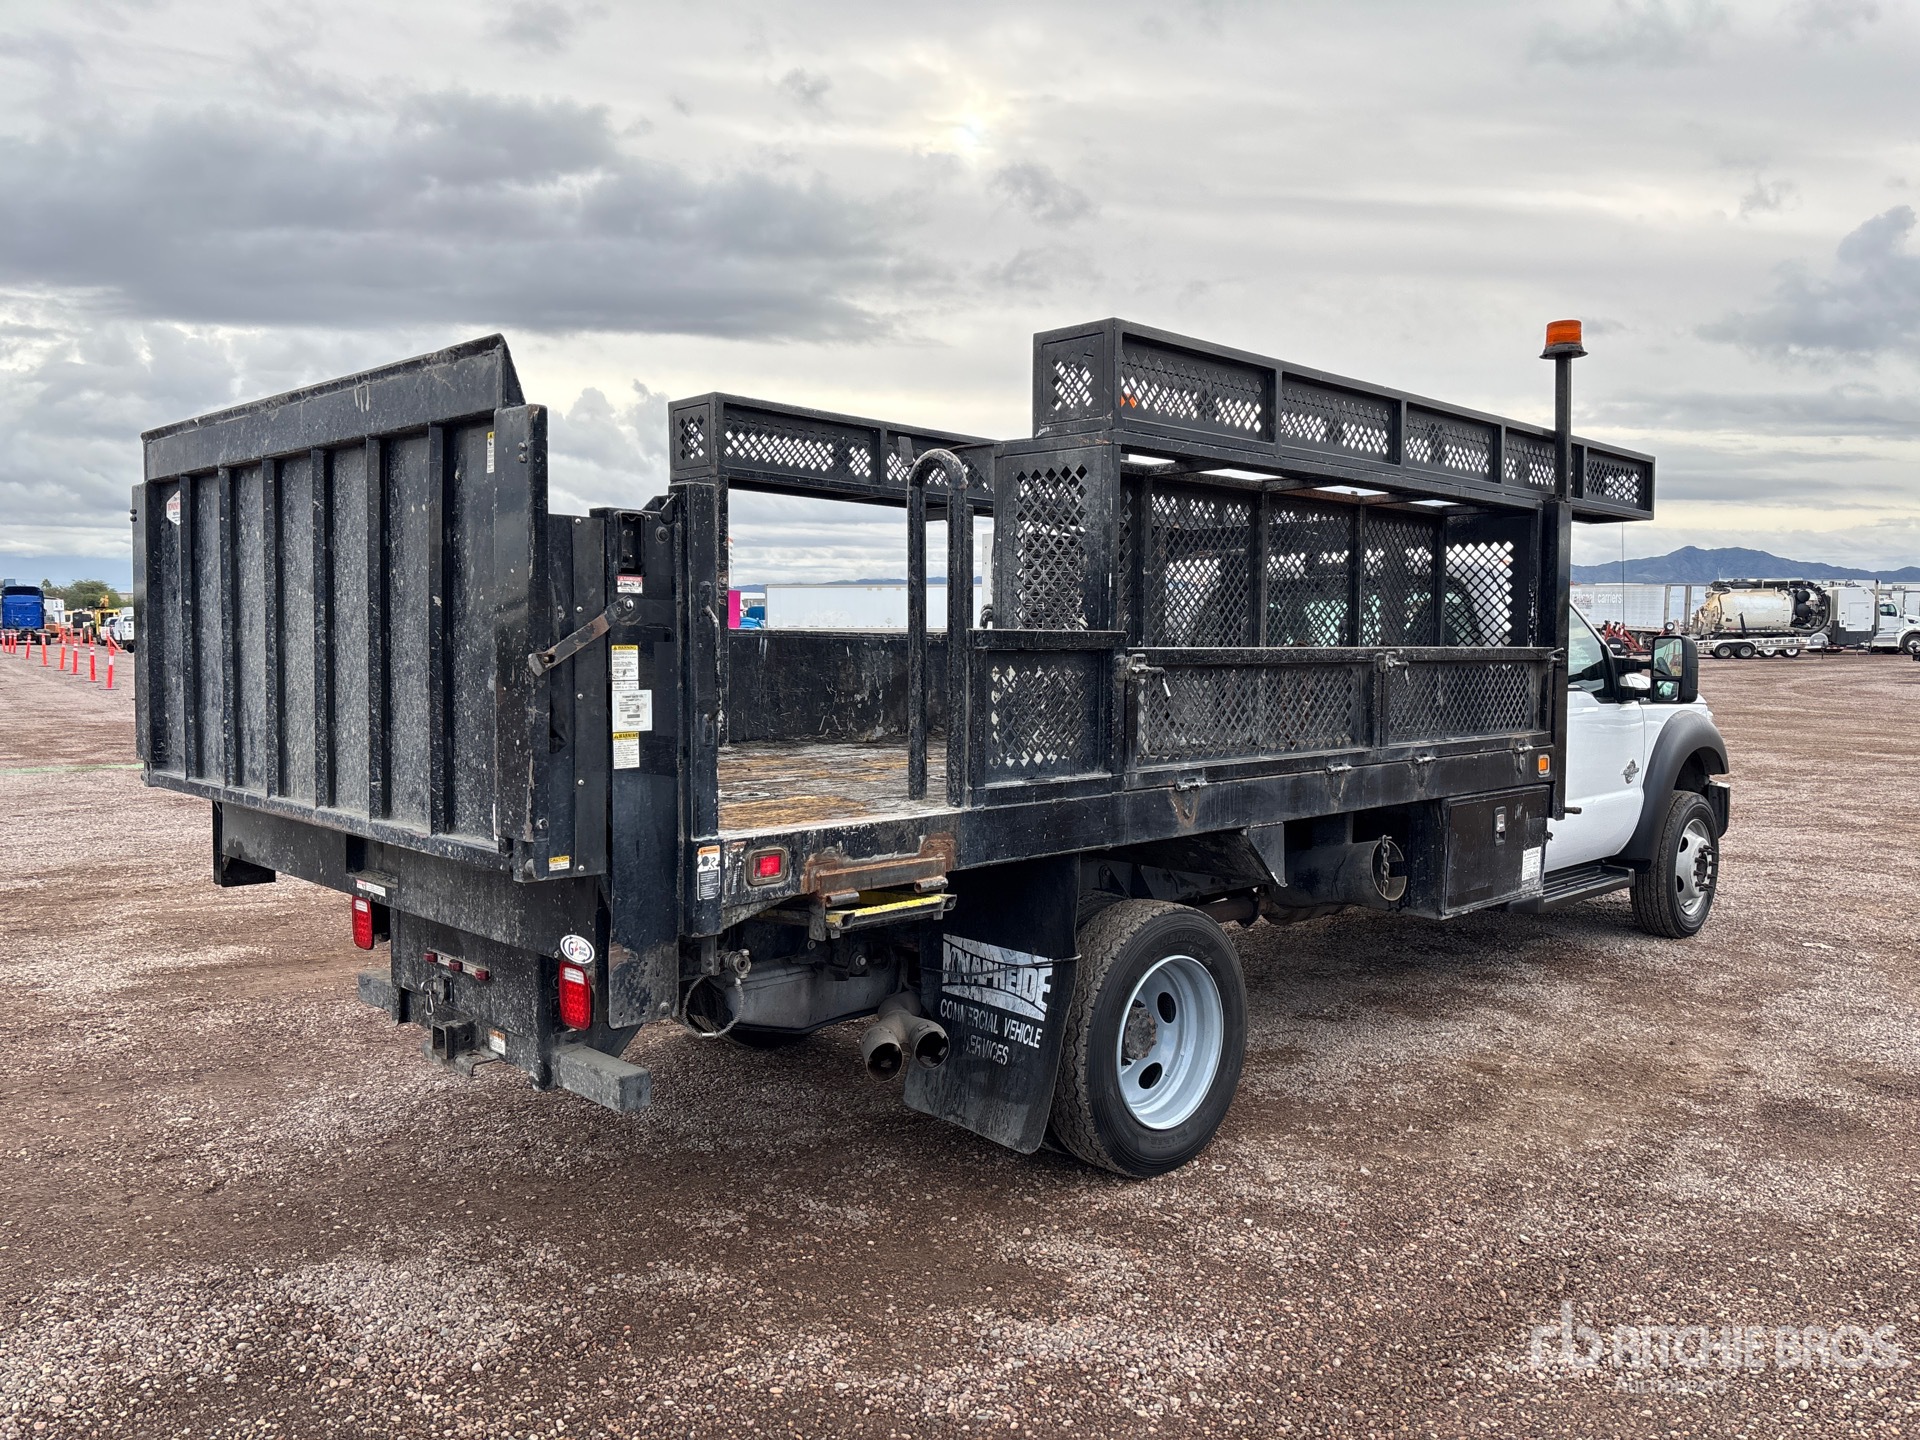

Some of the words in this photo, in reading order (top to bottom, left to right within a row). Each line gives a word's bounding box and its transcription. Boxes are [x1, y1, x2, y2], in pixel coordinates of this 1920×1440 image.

[1597, 591, 1623, 604] carriers
[942, 940, 1053, 1012] KNAPHEIDE
[1004, 1017, 1043, 1049] VEHICLE
